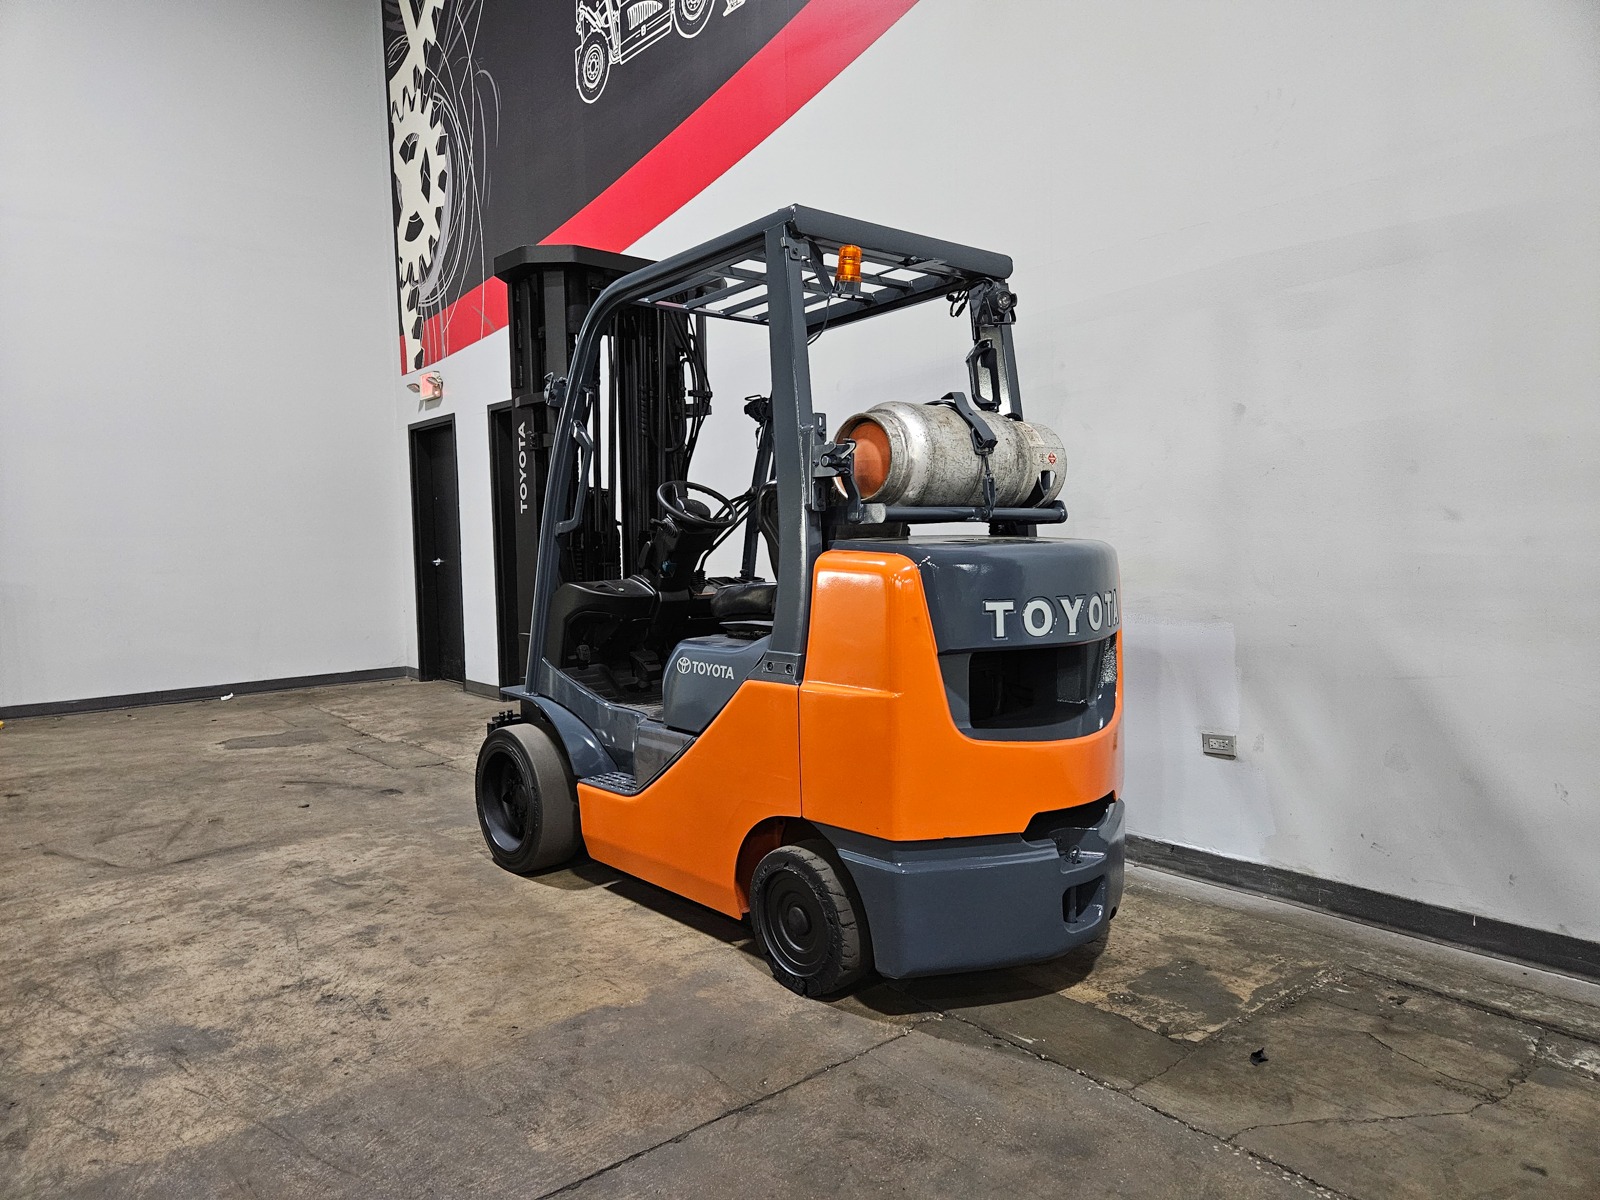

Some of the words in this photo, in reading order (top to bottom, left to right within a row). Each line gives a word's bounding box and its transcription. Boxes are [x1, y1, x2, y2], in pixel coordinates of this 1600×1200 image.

[518, 421, 528, 515] TOYOTA
[984, 589, 1119, 639] TOYOTA
[692, 660, 735, 680] TOYOTA
